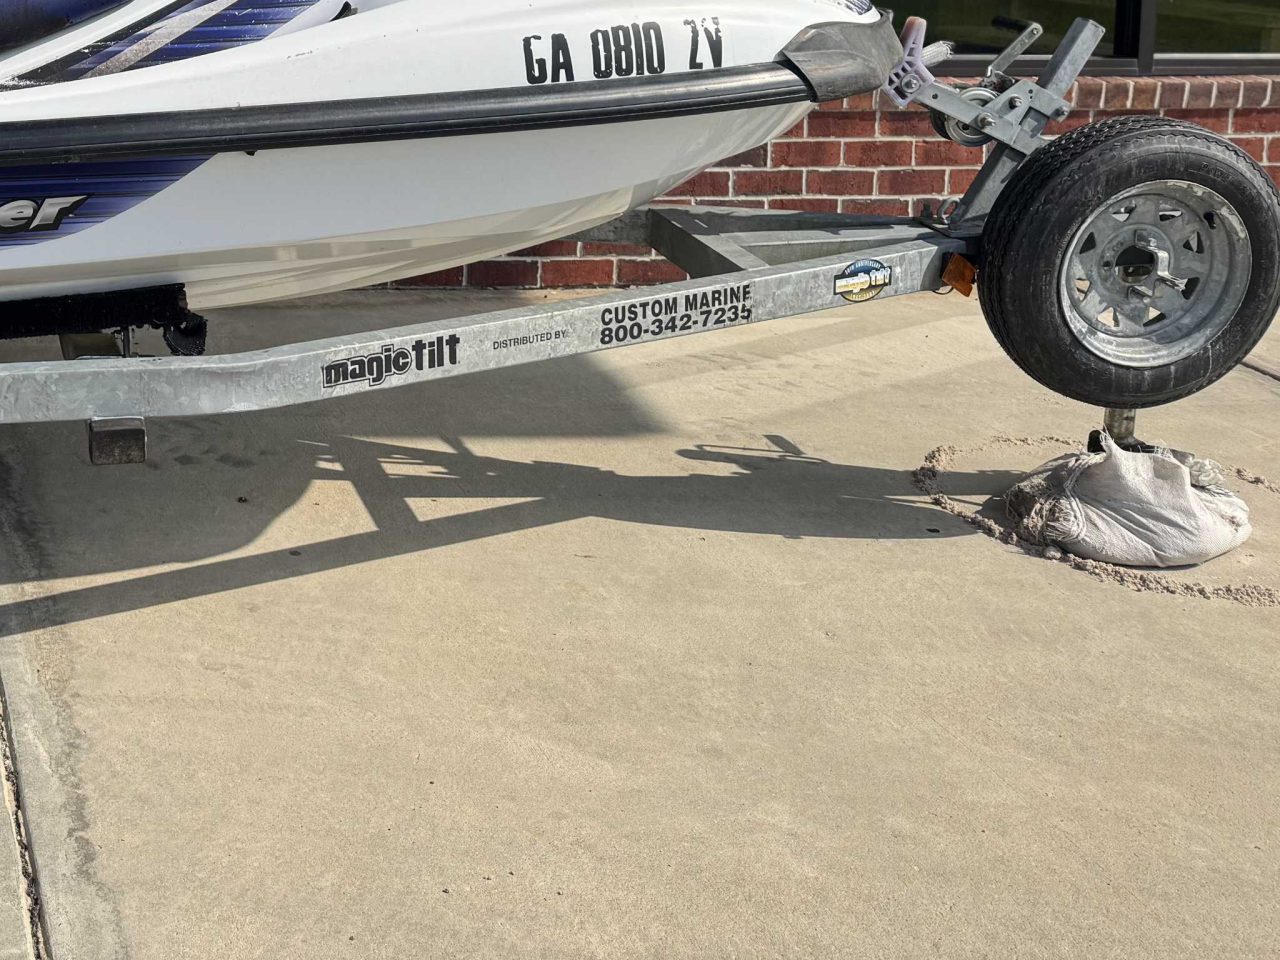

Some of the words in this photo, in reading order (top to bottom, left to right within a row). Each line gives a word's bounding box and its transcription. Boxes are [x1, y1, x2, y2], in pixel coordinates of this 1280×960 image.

[522, 34, 575, 85] GA
[590, 21, 666, 79] 0810
[600, 296, 678, 326] CUSTOM
[684, 284, 751, 312] MARINE
[600, 303, 753, 345] 800-342-7235
[492, 332, 552, 350] DISTRIBUTED
[554, 329, 567, 339] BY
